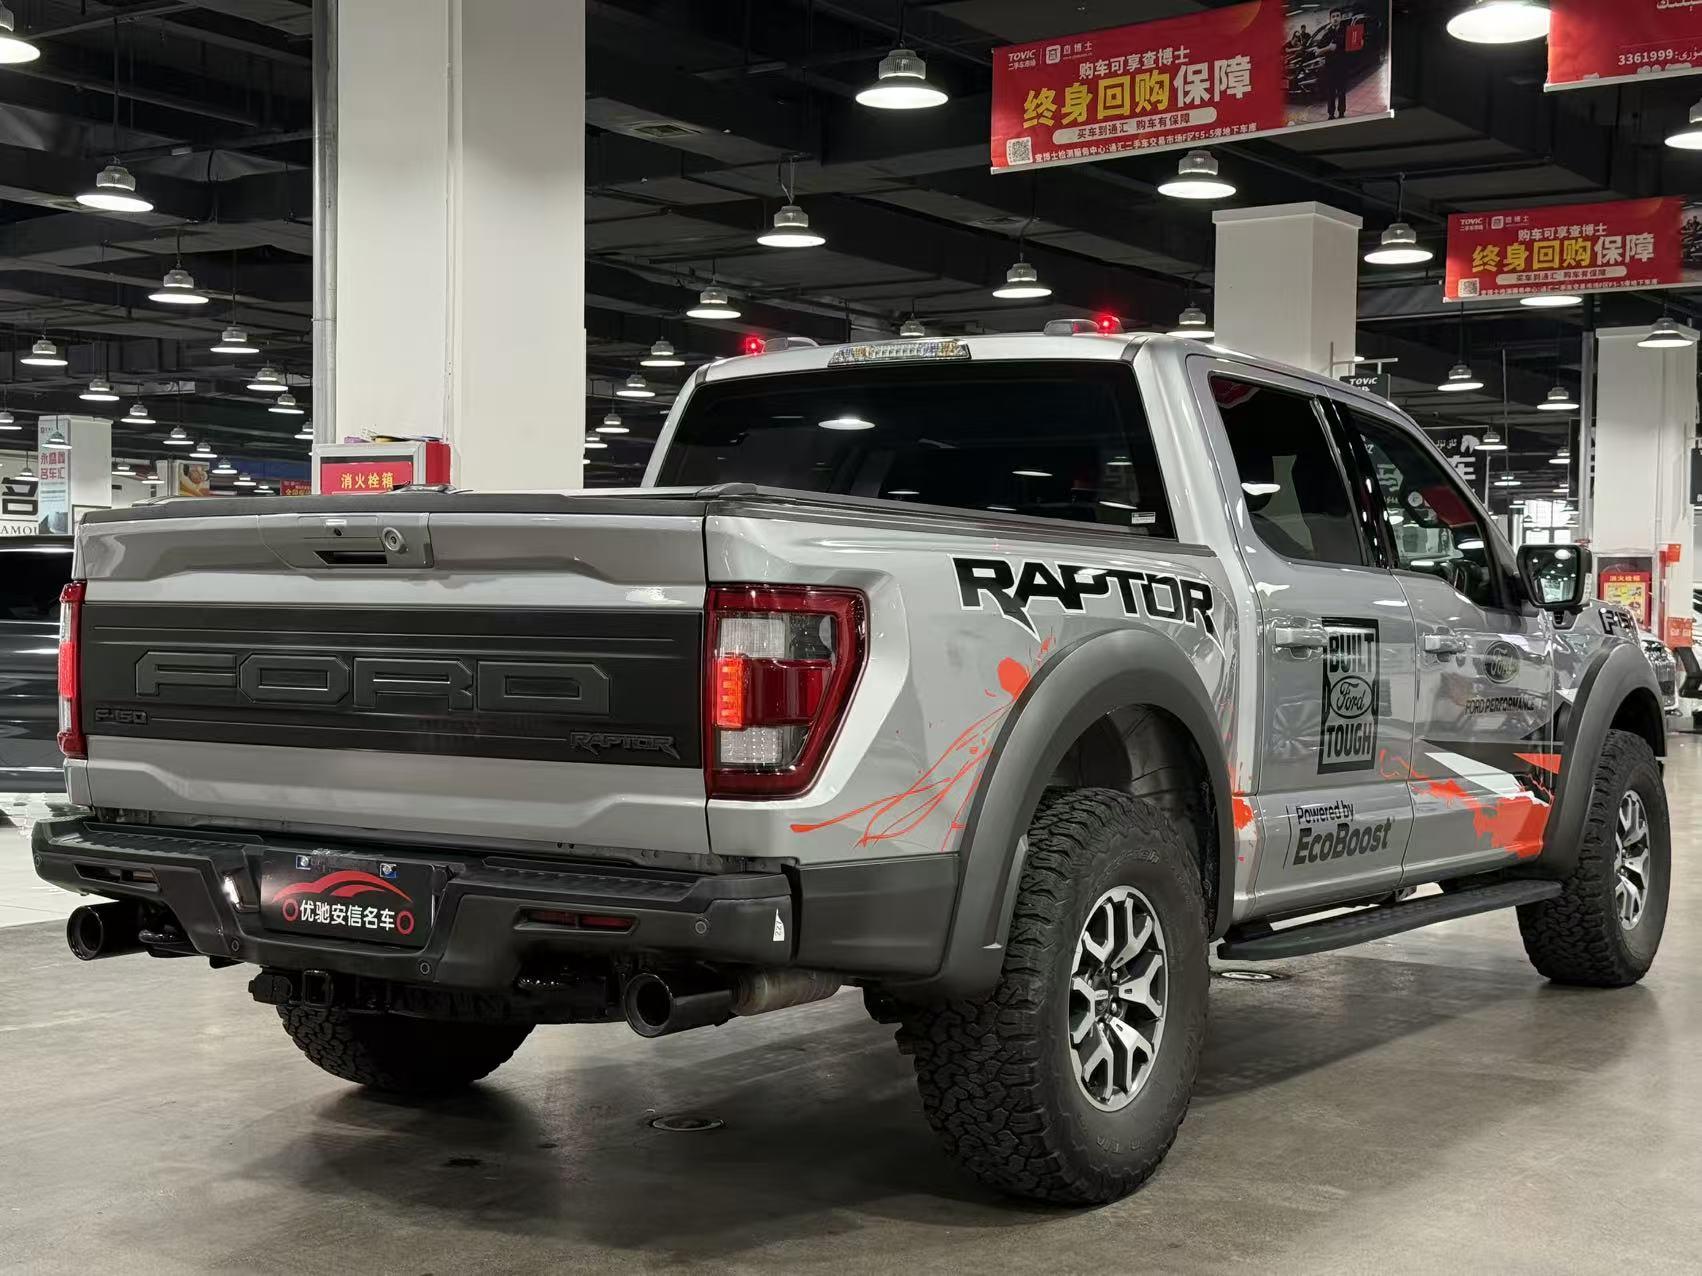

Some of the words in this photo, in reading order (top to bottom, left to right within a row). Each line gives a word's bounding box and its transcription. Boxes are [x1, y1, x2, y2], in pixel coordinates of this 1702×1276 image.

[1008, 49, 1037, 62] TOVIC
[1079, 45, 1190, 80] 购车可享查博士
[1618, 48, 1673, 66] 3361999
[1022, 54, 1253, 130] 终身回购保障
[1076, 121, 1129, 140] 买车到通汇
[1135, 111, 1191, 131] 购车有保障
[1518, 223, 1607, 242] 购车可享查博士
[1472, 232, 1655, 273] 终身回购保障
[1349, 377, 1378, 385] TOVIC
[341, 471, 393, 490] 消火栓箱
[948, 554, 1226, 661] RAPTOR
[1329, 632, 1375, 673] BUILT
[135, 650, 611, 715] FORD
[1336, 681, 1367, 712] Ford
[1464, 700, 1485, 715] FORD
[1485, 697, 1534, 713] PERFORMANCE
[570, 731, 680, 760] RAPTOR
[1326, 722, 1373, 759] TOUGH
[1296, 802, 1341, 824] Powered
[1342, 800, 1354, 822] by
[1293, 818, 1392, 866] EcoBoost
[300, 900, 395, 931] 优驰安信名车
